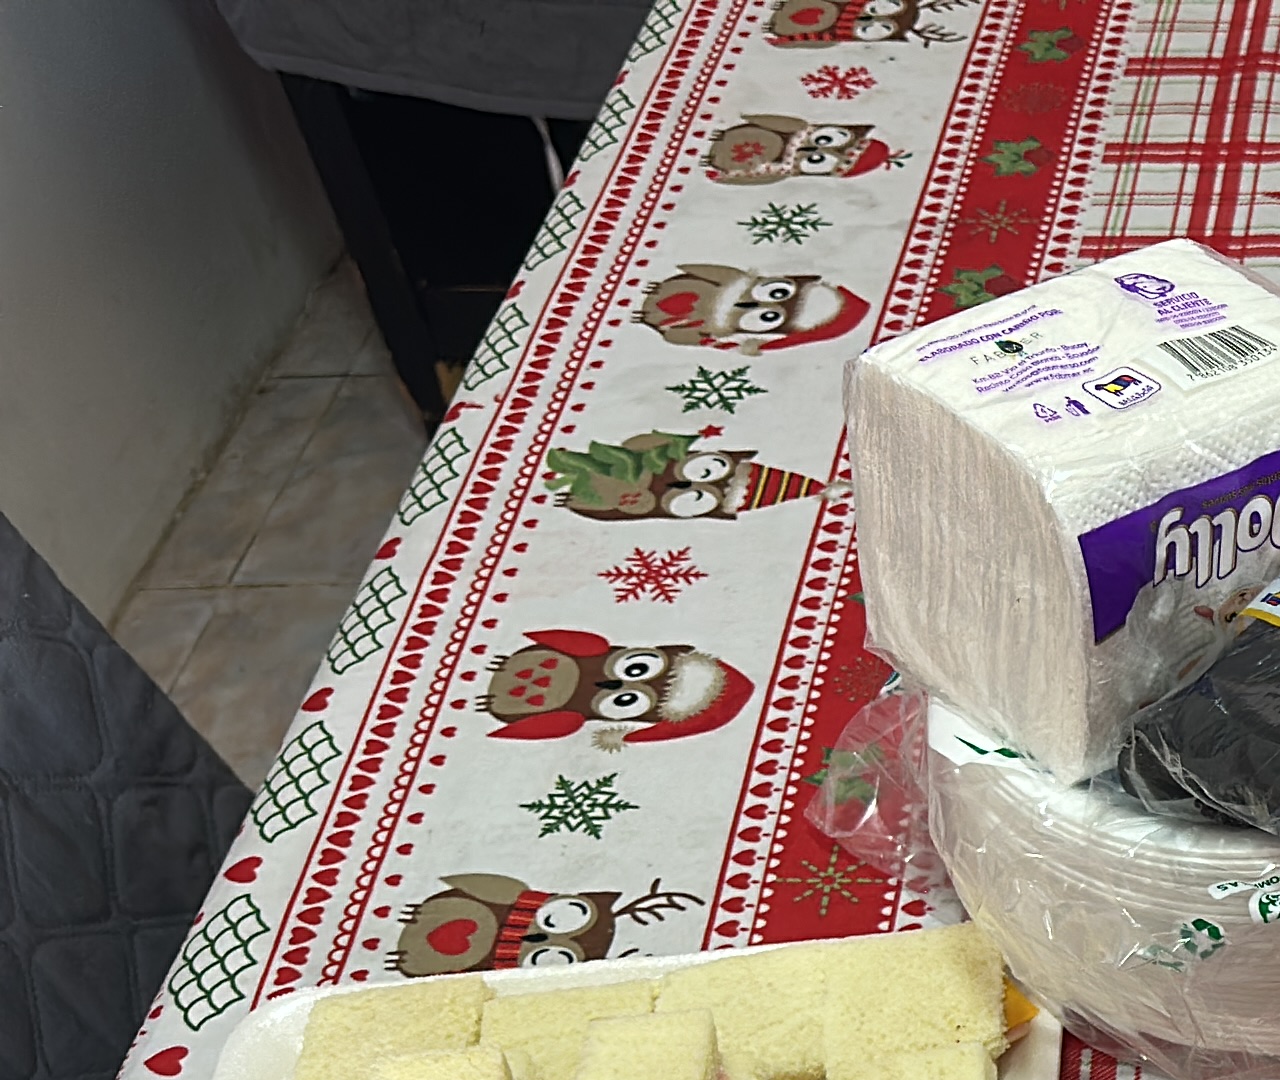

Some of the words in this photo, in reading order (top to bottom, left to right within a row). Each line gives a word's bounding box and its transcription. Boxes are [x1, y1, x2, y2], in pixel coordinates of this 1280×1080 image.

[1153, 292, 1199, 308] SERVICIO
[1173, 298, 1212, 314] CLIENTE
[918, 338, 980, 363] ELABORADO
[979, 332, 1001, 343] CON
[1238, 347, 1278, 366] 350134
